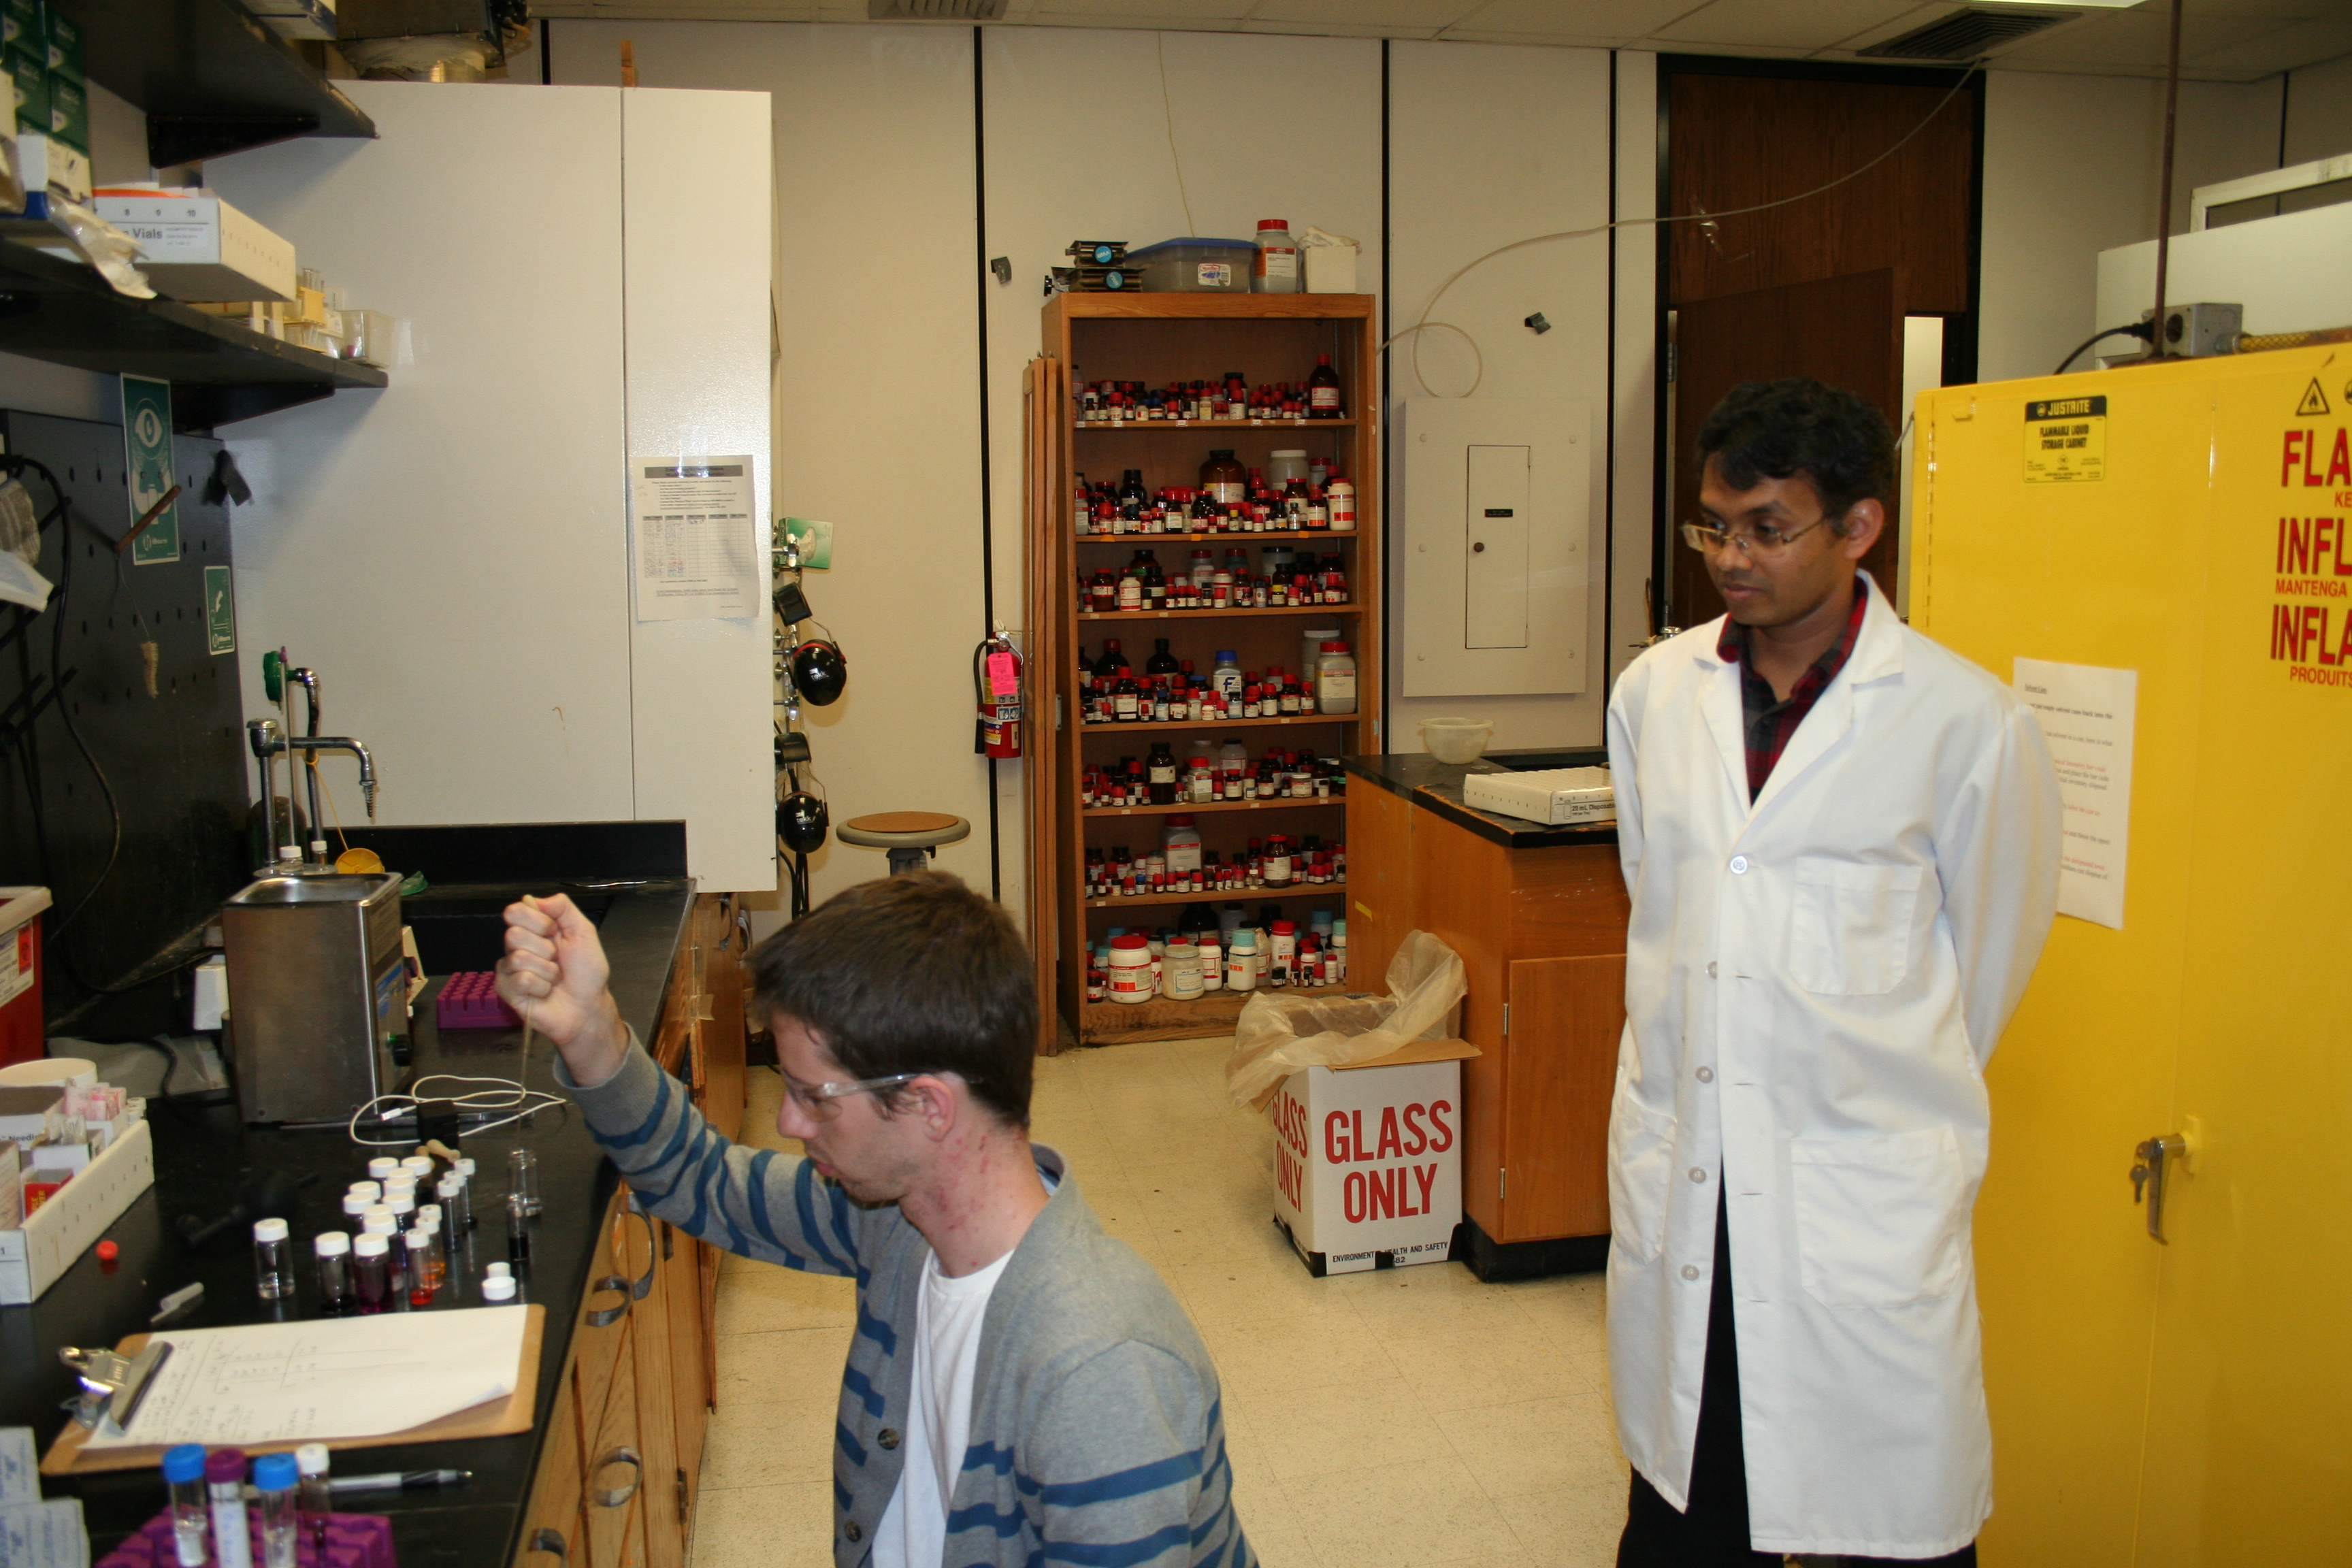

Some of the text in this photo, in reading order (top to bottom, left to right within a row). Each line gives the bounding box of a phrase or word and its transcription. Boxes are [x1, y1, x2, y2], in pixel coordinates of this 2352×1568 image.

[133, 228, 163, 239] Vials
[2048, 399, 2091, 416] JUSTRITE
[2276, 578, 2347, 598] MANTENGA
[1324, 1100, 1453, 1164] GLASS
[1277, 1140, 1303, 1213] ONLY
[1343, 1162, 1438, 1224] ONLY
[1333, 1251, 1377, 1262] ENVIRONMENT
[1410, 1245, 1422, 1253] AND
[1425, 1241, 1448, 1251] SAFETY
